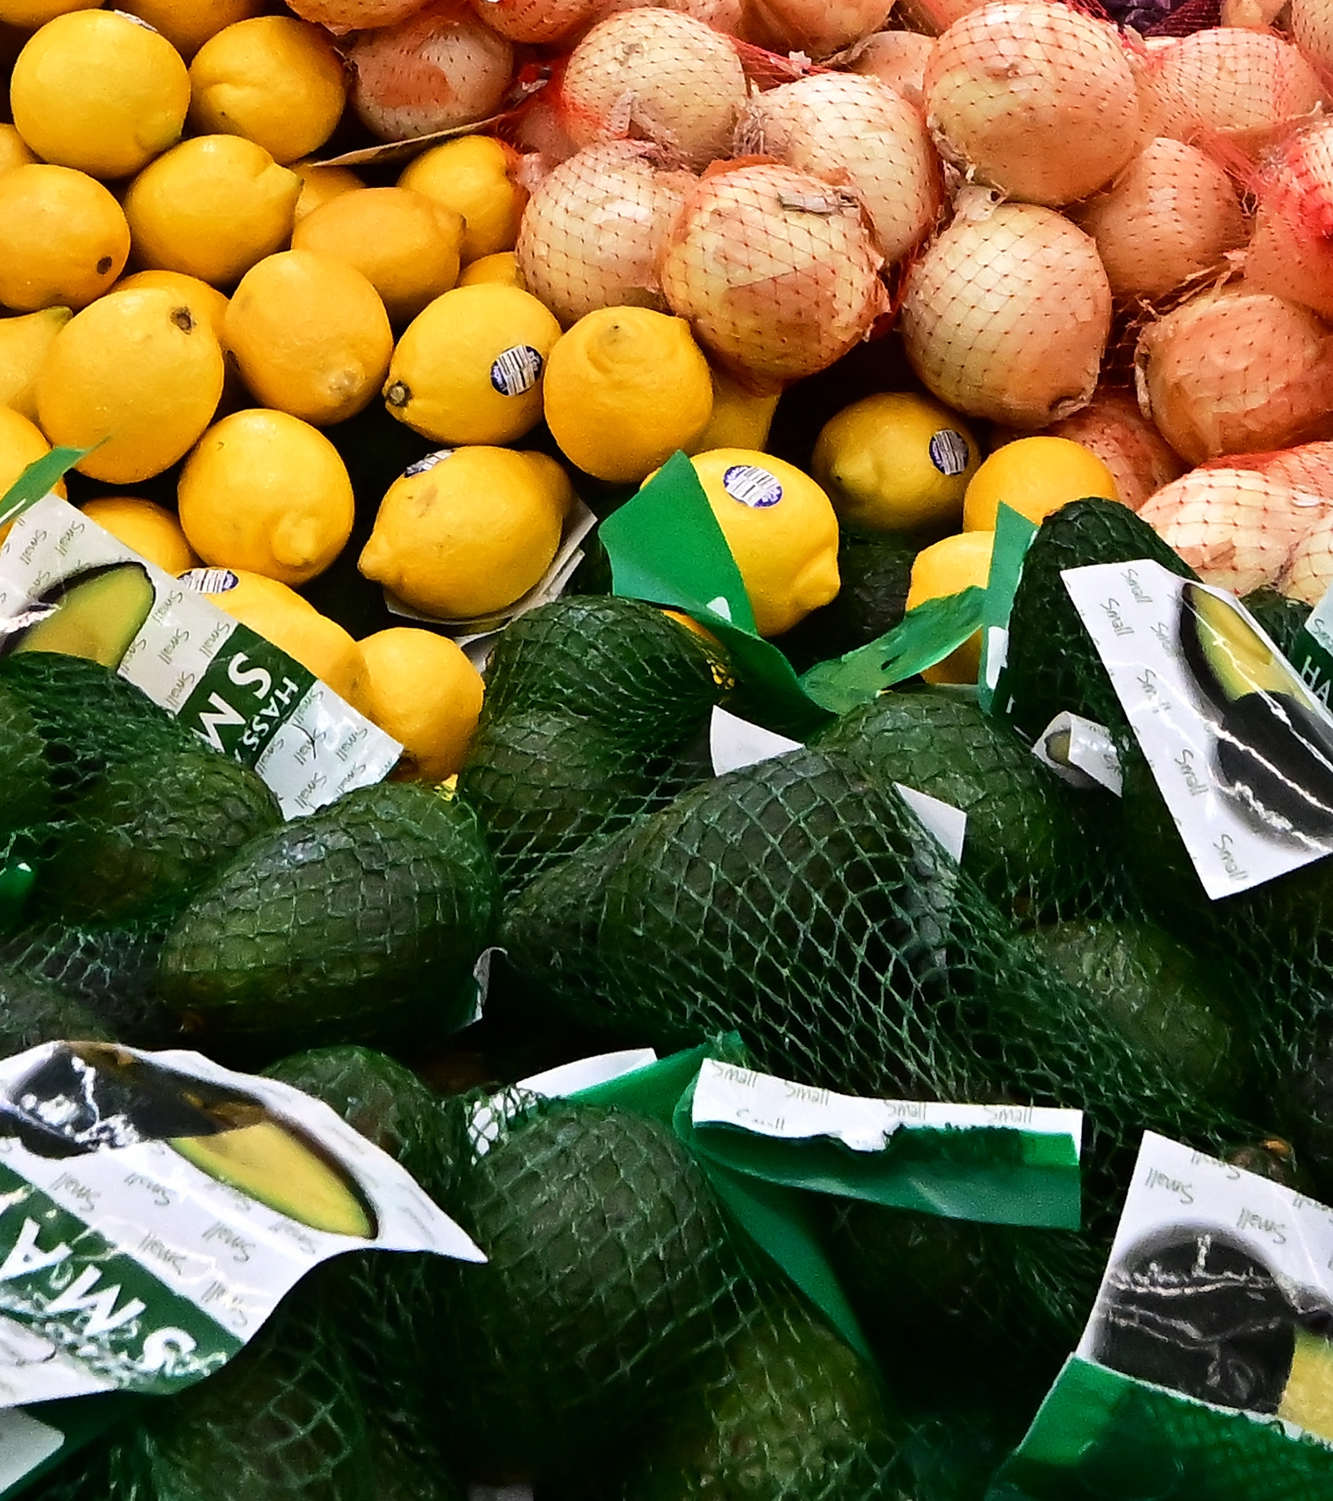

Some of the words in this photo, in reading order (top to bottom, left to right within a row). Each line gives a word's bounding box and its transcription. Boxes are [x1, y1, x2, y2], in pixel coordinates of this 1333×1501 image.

[1119, 568, 1149, 605] Small
[1099, 598, 1131, 637] Small
[198, 622, 232, 657] Small
[241, 676, 299, 764] HASS
[1173, 749, 1204, 798] Small
[1213, 833, 1250, 883] Small
[713, 1062, 756, 1088] Small
[785, 1081, 829, 1105] Small
[884, 1101, 927, 1121] Small
[983, 1105, 1033, 1124] Small
[1145, 1168, 1193, 1205] Small
[1236, 1205, 1288, 1245] Small
